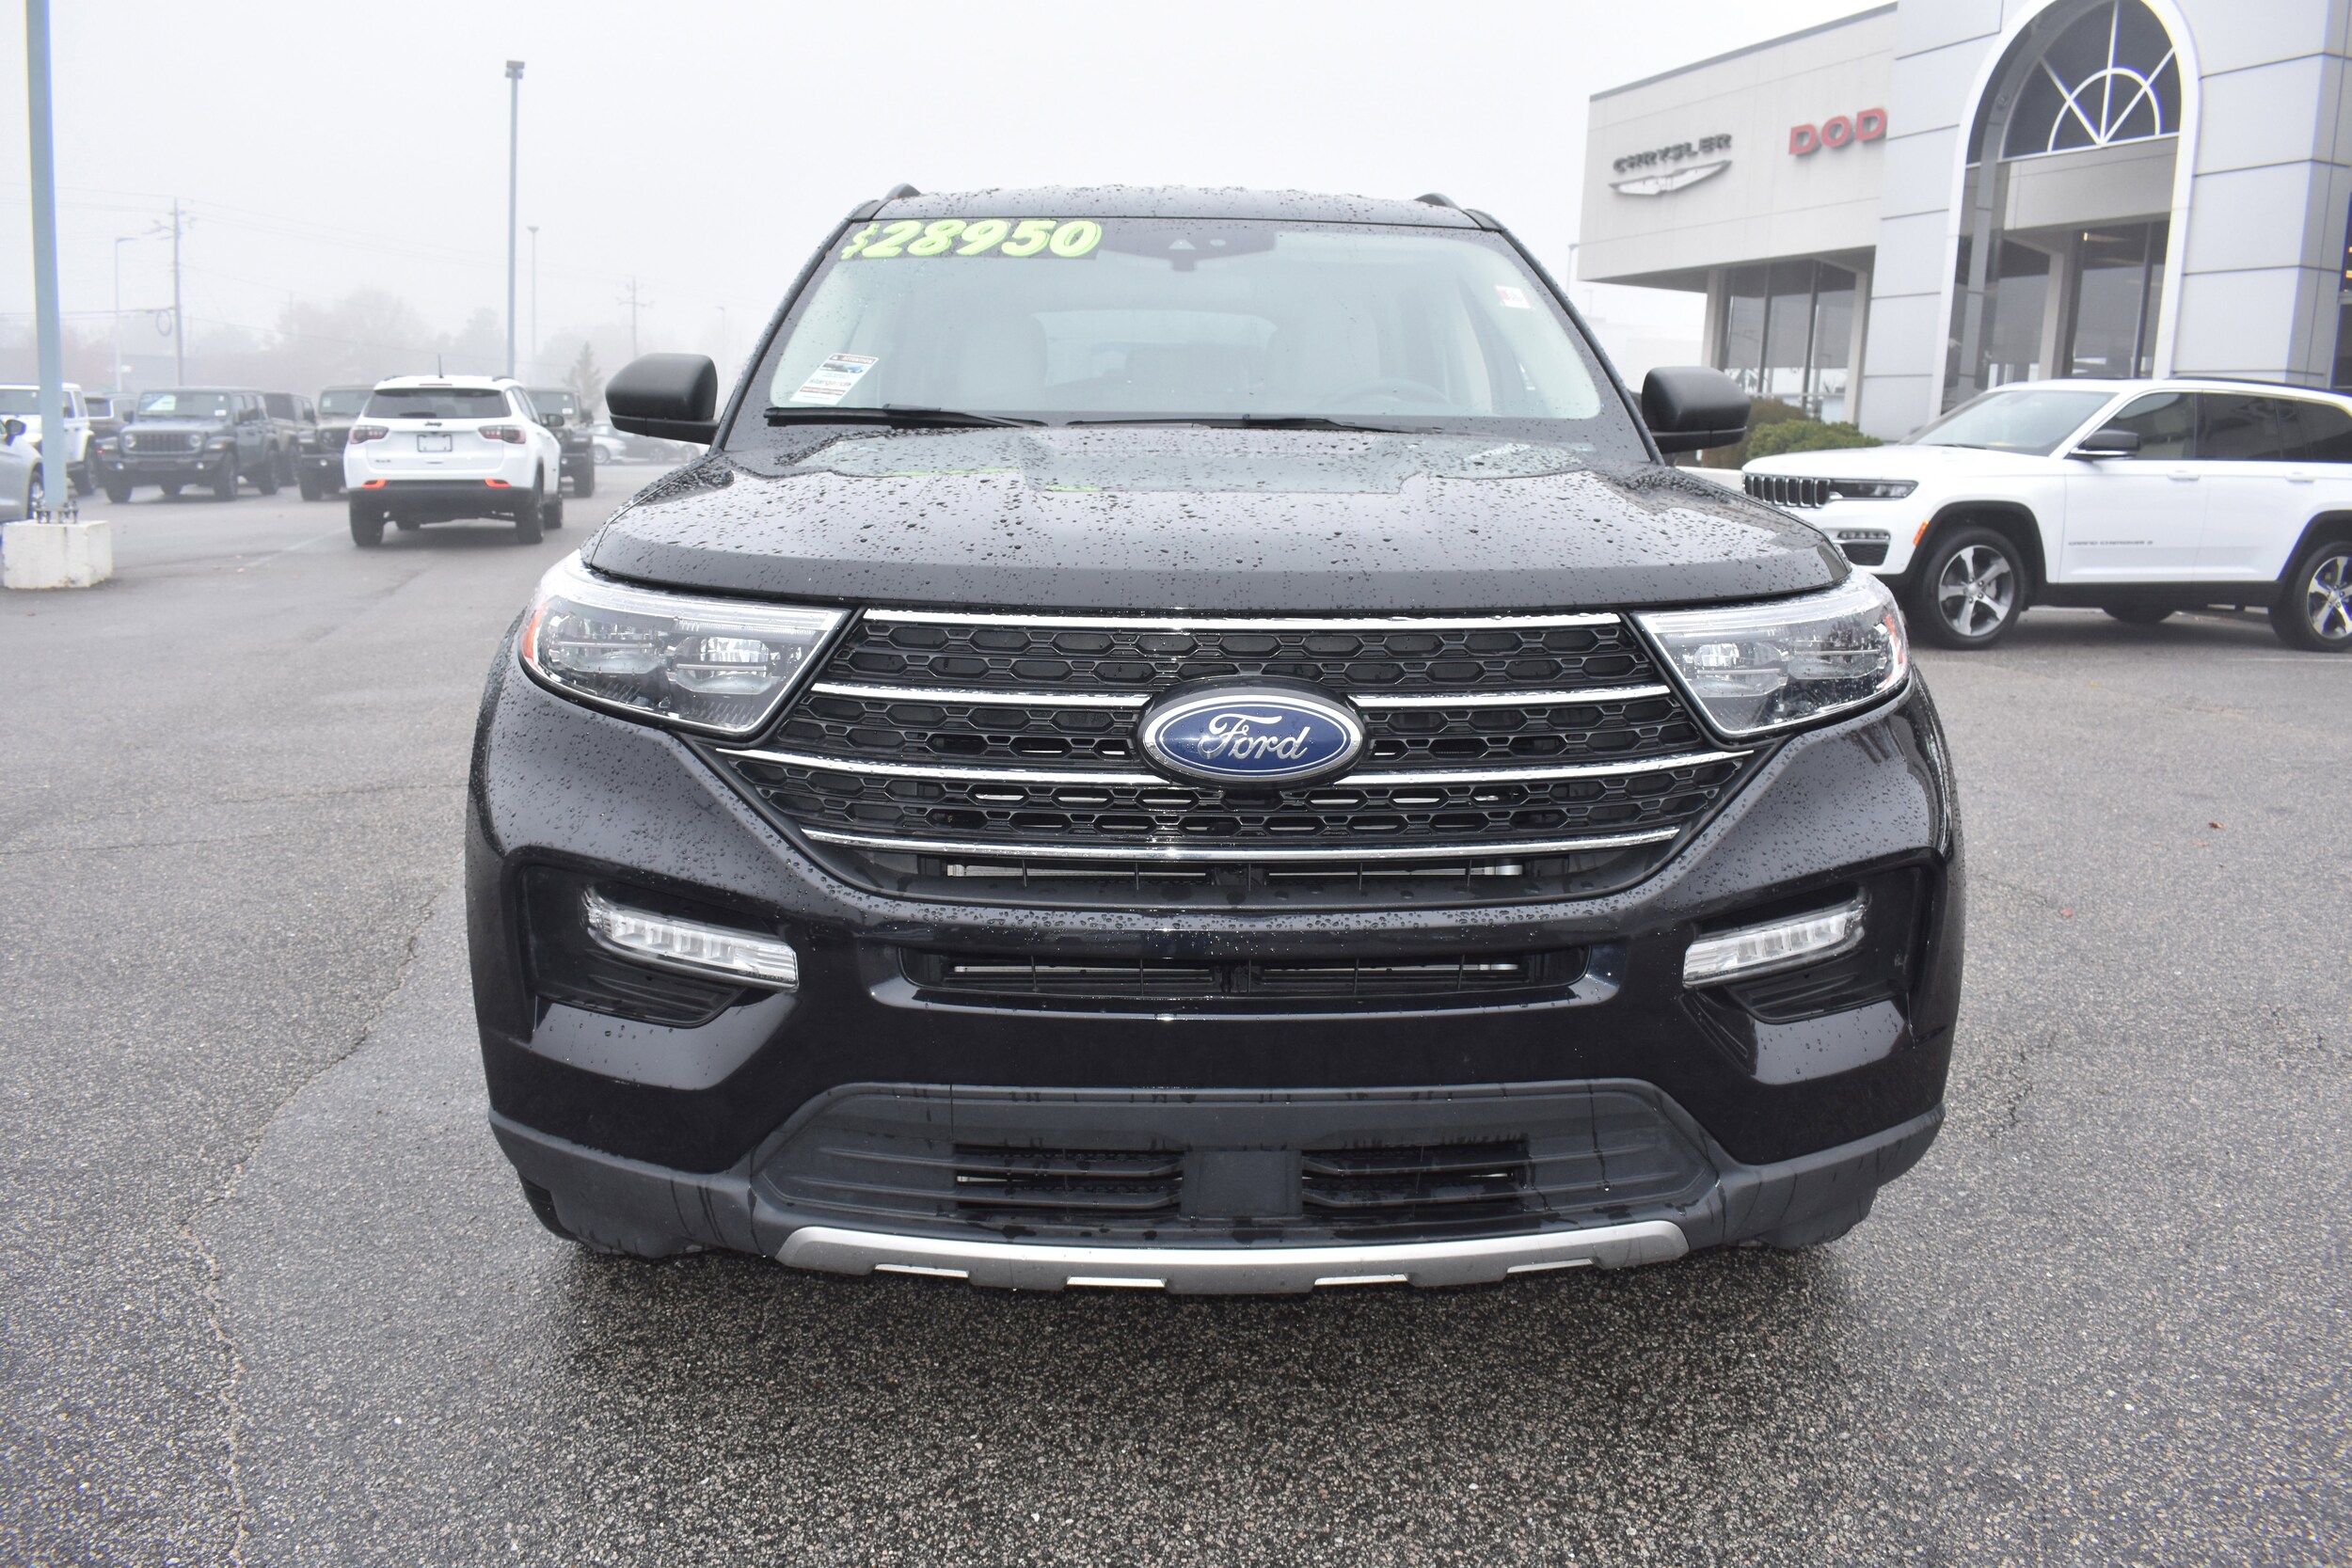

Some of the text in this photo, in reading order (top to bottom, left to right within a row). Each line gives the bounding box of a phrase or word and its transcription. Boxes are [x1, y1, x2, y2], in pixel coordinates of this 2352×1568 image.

[1613, 133, 1732, 173] CHRYSLER
[1788, 107, 1887, 156] DOD
[841, 219, 1103, 260] $28950
[1198, 713, 1311, 760] Ford
